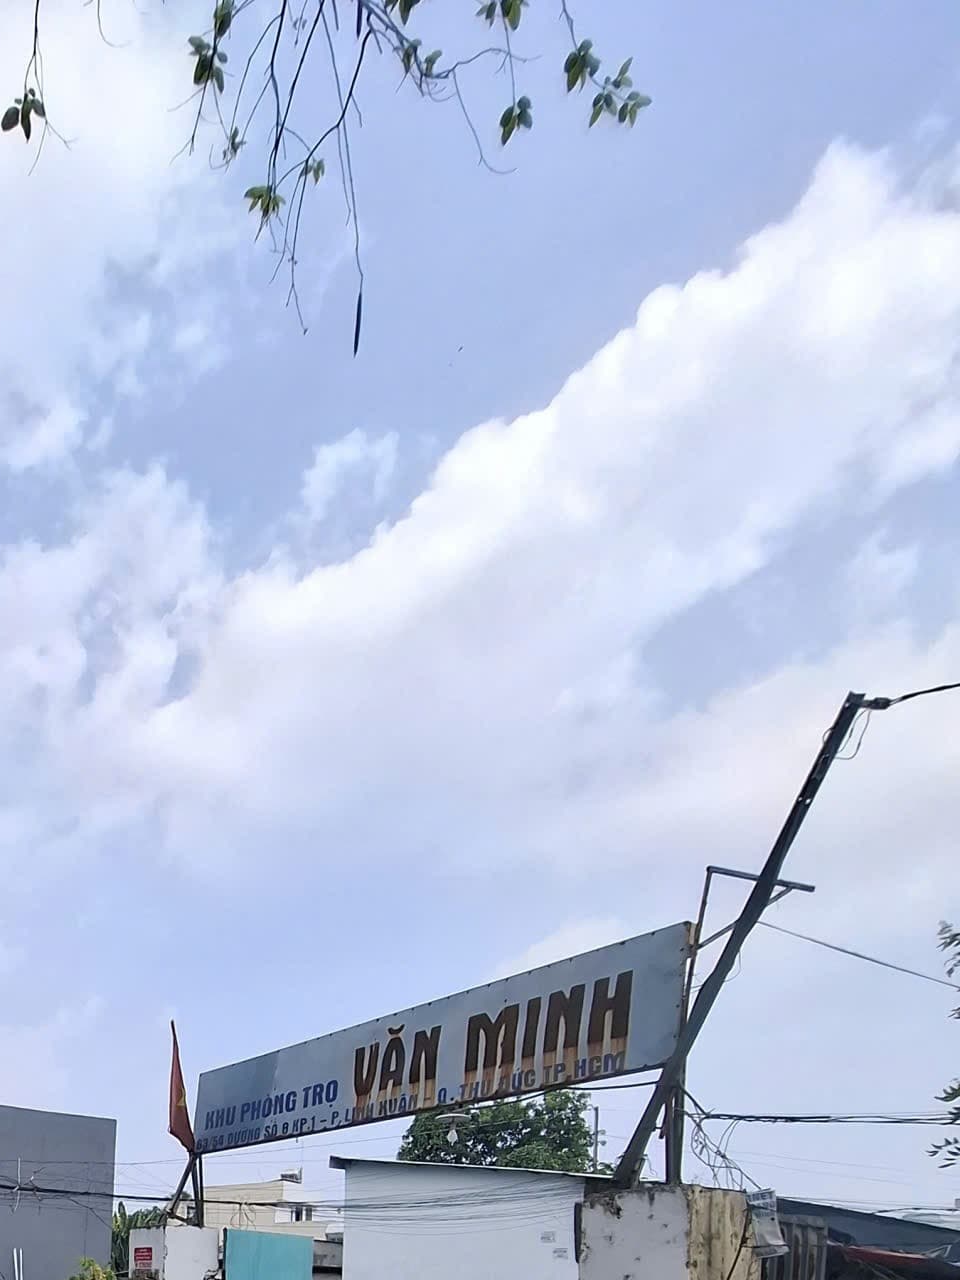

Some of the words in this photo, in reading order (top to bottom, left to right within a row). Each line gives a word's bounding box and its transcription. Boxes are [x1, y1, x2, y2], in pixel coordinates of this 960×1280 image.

[354, 1023, 442, 1097] VĂN
[464, 970, 633, 1073] MINH
[204, 1105, 237, 1130] KHU
[240, 1090, 298, 1122] PHÒNG
[302, 1079, 339, 1108] TRỌ
[263, 1120, 278, 1138] SỐ
